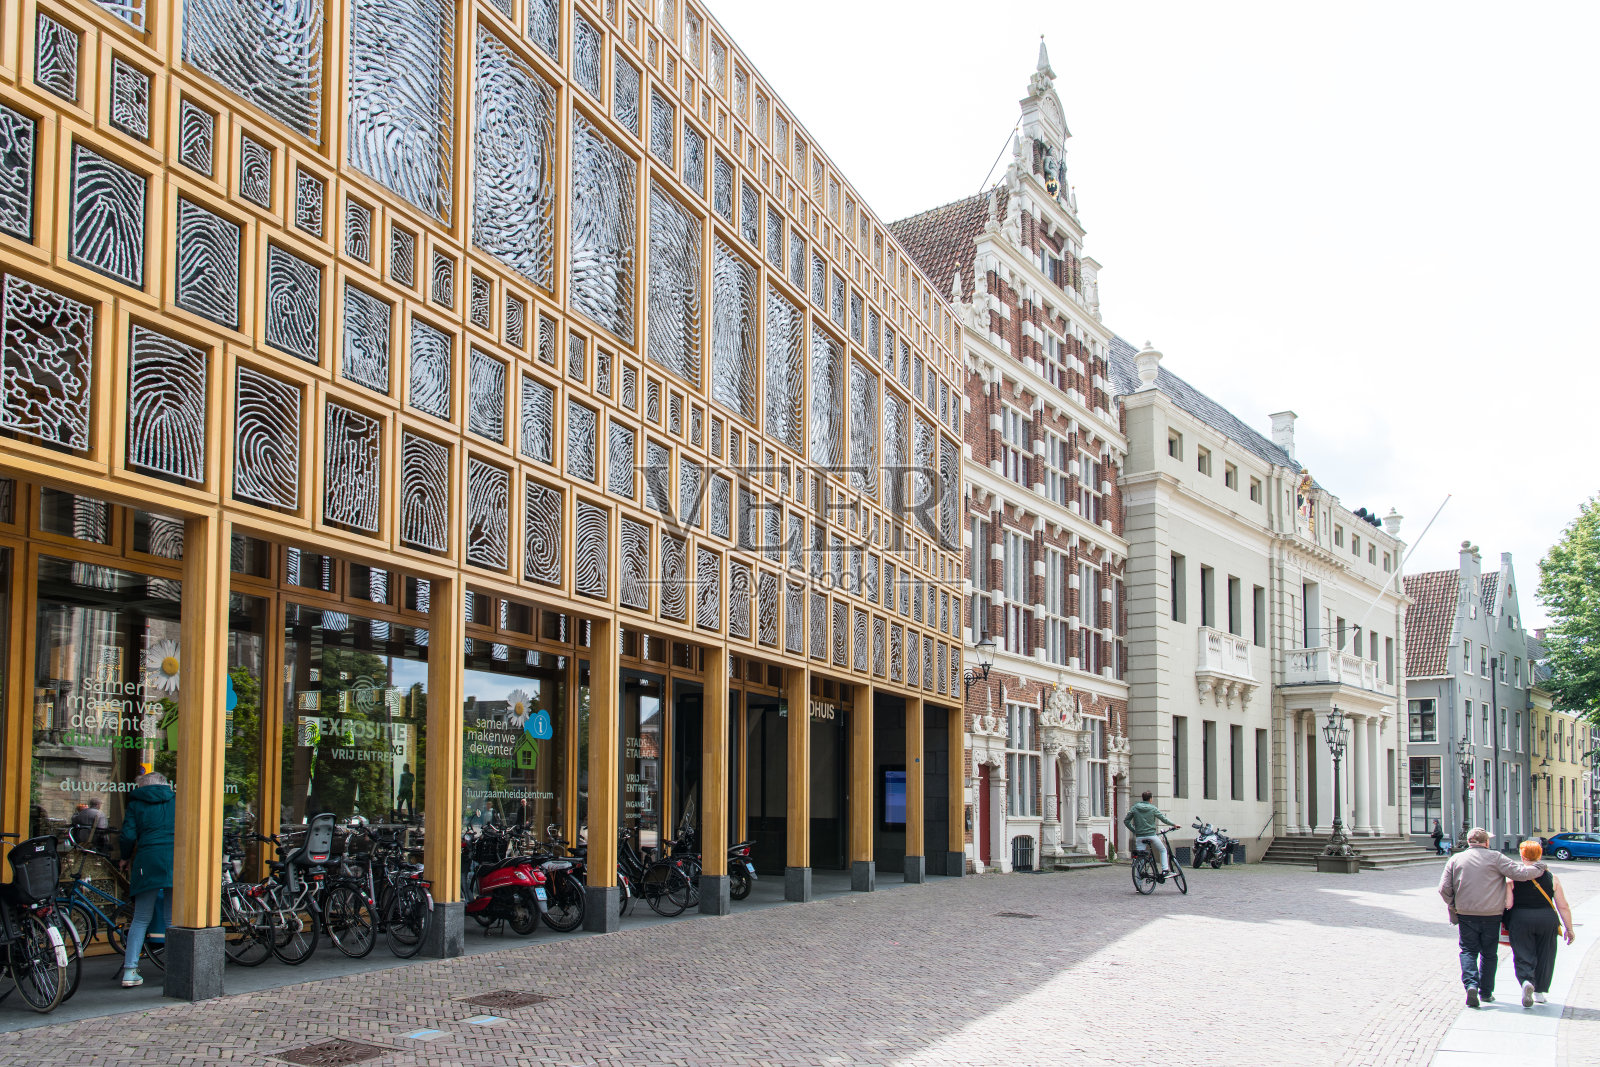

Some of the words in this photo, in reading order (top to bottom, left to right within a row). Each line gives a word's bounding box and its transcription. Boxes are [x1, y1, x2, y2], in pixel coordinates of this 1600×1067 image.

[82, 677, 146, 696] samen
[66, 694, 134, 715] maken
[136, 701, 164, 716] we
[810, 700, 835, 720] DHUIS
[70, 711, 159, 733] deventer
[319, 717, 406, 742] EXPOSITIE
[476, 718, 508, 731] samen
[62, 729, 164, 750] duurzaam
[467, 729, 502, 742] maken
[502, 734, 516, 744] we
[331, 748, 355, 760] VRIJ
[469, 741, 513, 756] deventer
[626, 773, 640, 783] VRIJ
[626, 783, 649, 793] ENTREE
